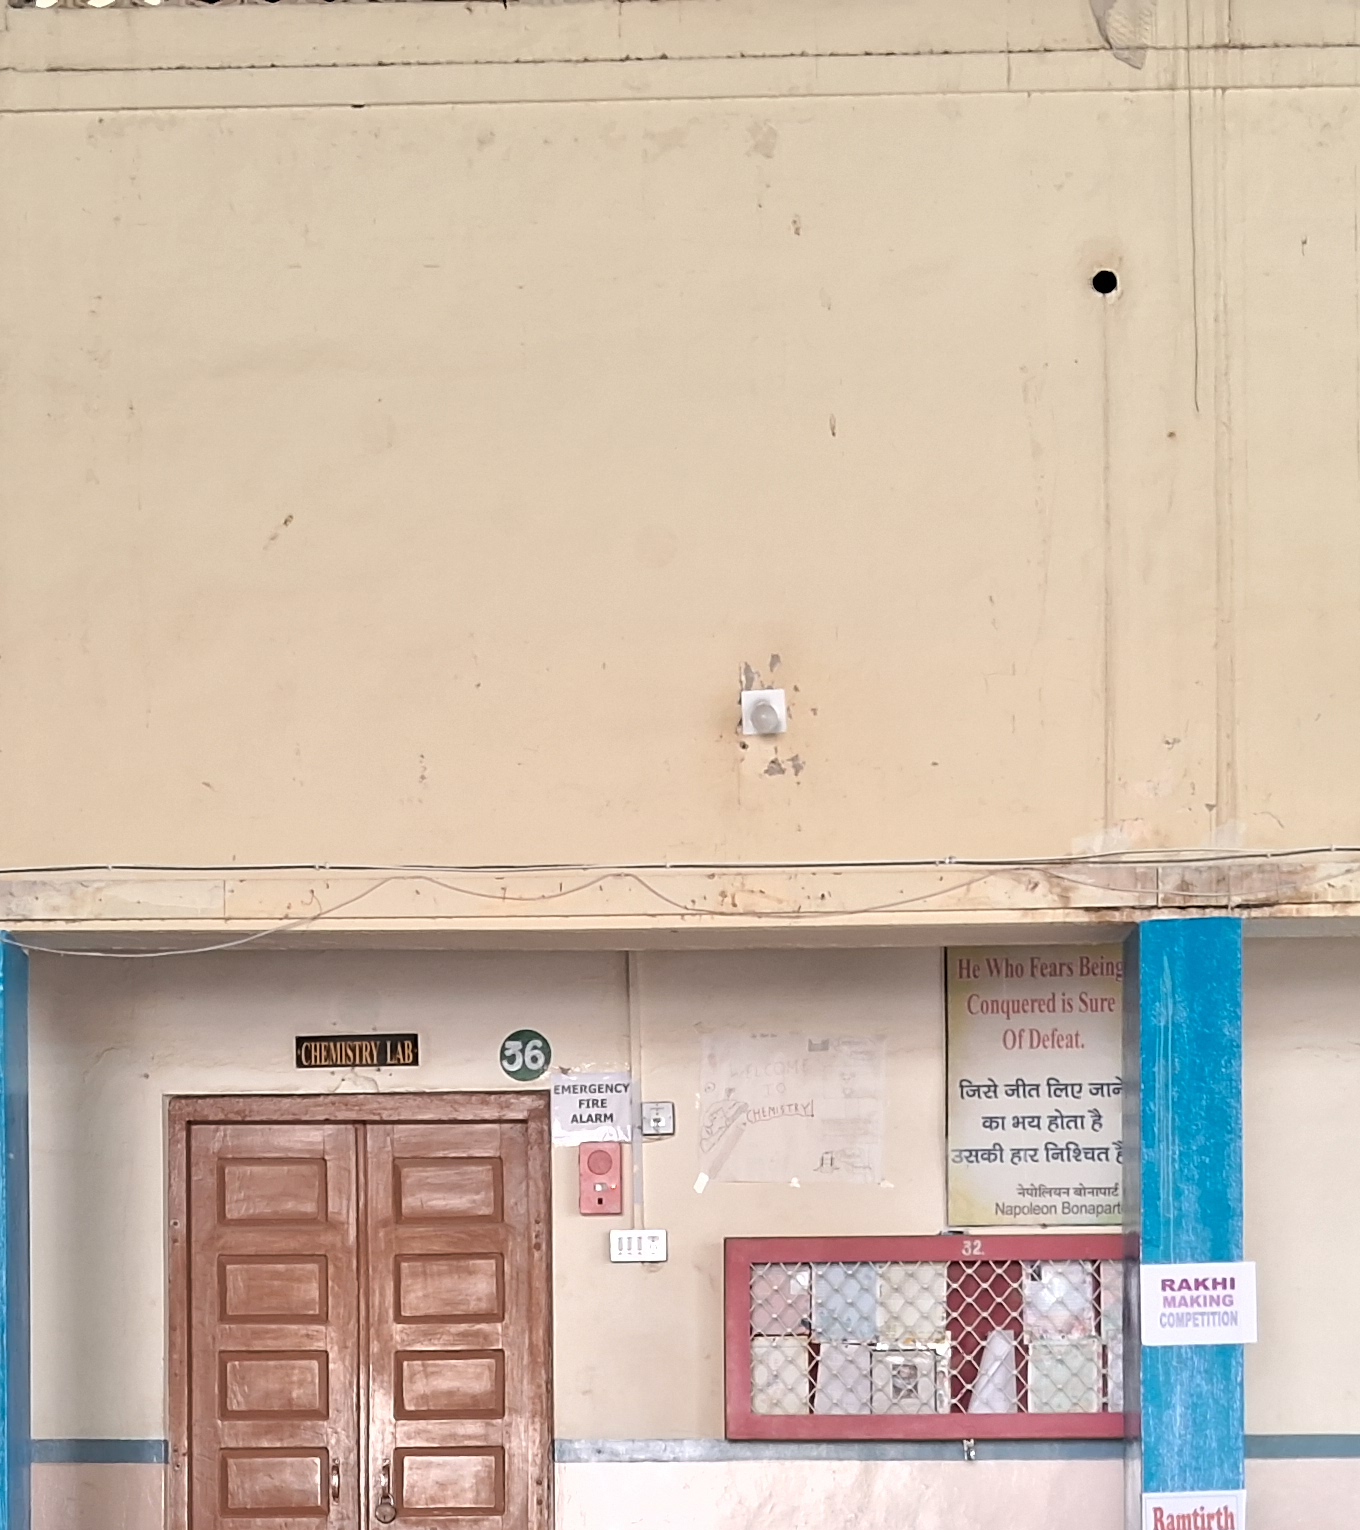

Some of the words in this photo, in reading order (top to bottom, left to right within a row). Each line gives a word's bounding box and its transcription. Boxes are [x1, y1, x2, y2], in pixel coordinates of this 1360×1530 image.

[958, 957, 981, 980] He
[985, 957, 1025, 979] Who
[1029, 956, 1074, 978] Fears
[1078, 955, 1123, 982] Being
[966, 991, 1056, 1020] Conquered
[1061, 992, 1074, 1013] is
[1078, 991, 1116, 1013] Sure
[1002, 1028, 1025, 1050] Of
[1028, 1027, 1085, 1050] Defeat.
[301, 1040, 380, 1066] CHEMISTRY
[386, 1039, 414, 1065] LAB
[501, 1039, 546, 1072] 36
[553, 1083, 631, 1095] EMERGENCY
[763, 1082, 786, 1096] TO
[959, 1077, 999, 1100] जिसे
[1004, 1077, 1040, 1099] जीत
[1046, 1077, 1083, 1099] लिए
[578, 1098, 608, 1109] FIRE
[570, 1112, 614, 1124] ALARM
[981, 1115, 1006, 1131] का
[1011, 1115, 1041, 1131] भय
[1046, 1108, 1086, 1132] होता
[1090, 1108, 1103, 1132] है
[951, 1142, 1005, 1164] उसकी
[1009, 1149, 1040, 1165] हार
[1043, 1141, 1109, 1163] निश्चित
[1016, 1183, 1071, 1198] नेपोलियन
[1073, 1182, 1120, 1198] बोनापार्ट
[994, 1201, 1058, 1219] Napoleon
[1061, 1201, 1124, 1218] Bonapart
[1161, 1277, 1236, 1292] RAKHI
[1162, 1294, 1234, 1309] MAKING
[1159, 1310, 1239, 1328] COMPETITION
